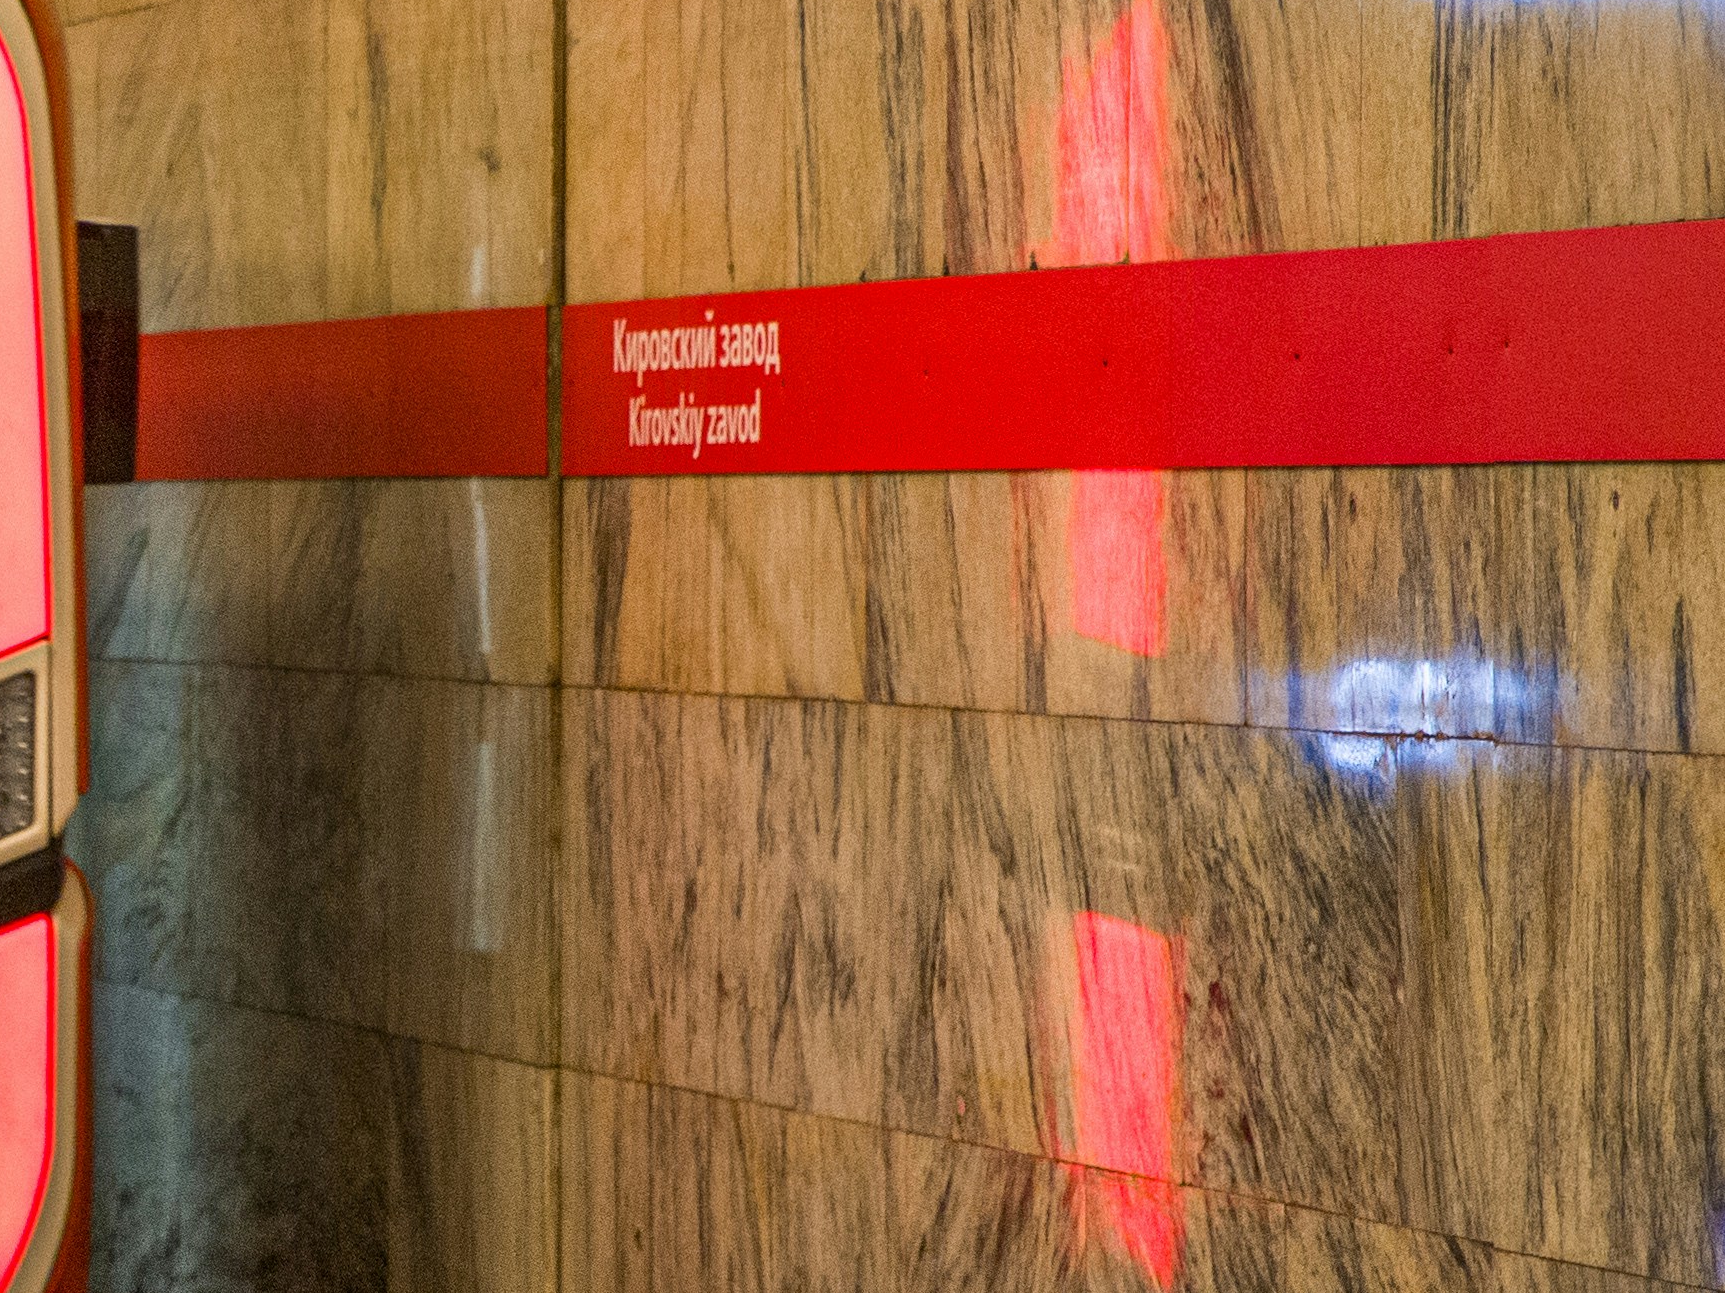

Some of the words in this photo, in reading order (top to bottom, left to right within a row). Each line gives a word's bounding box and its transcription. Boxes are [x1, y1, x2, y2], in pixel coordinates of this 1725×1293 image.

[613, 309, 717, 387] Кировский
[719, 320, 781, 375] завод
[628, 391, 704, 460] Kirovskiy
[706, 388, 762, 444] zavod
